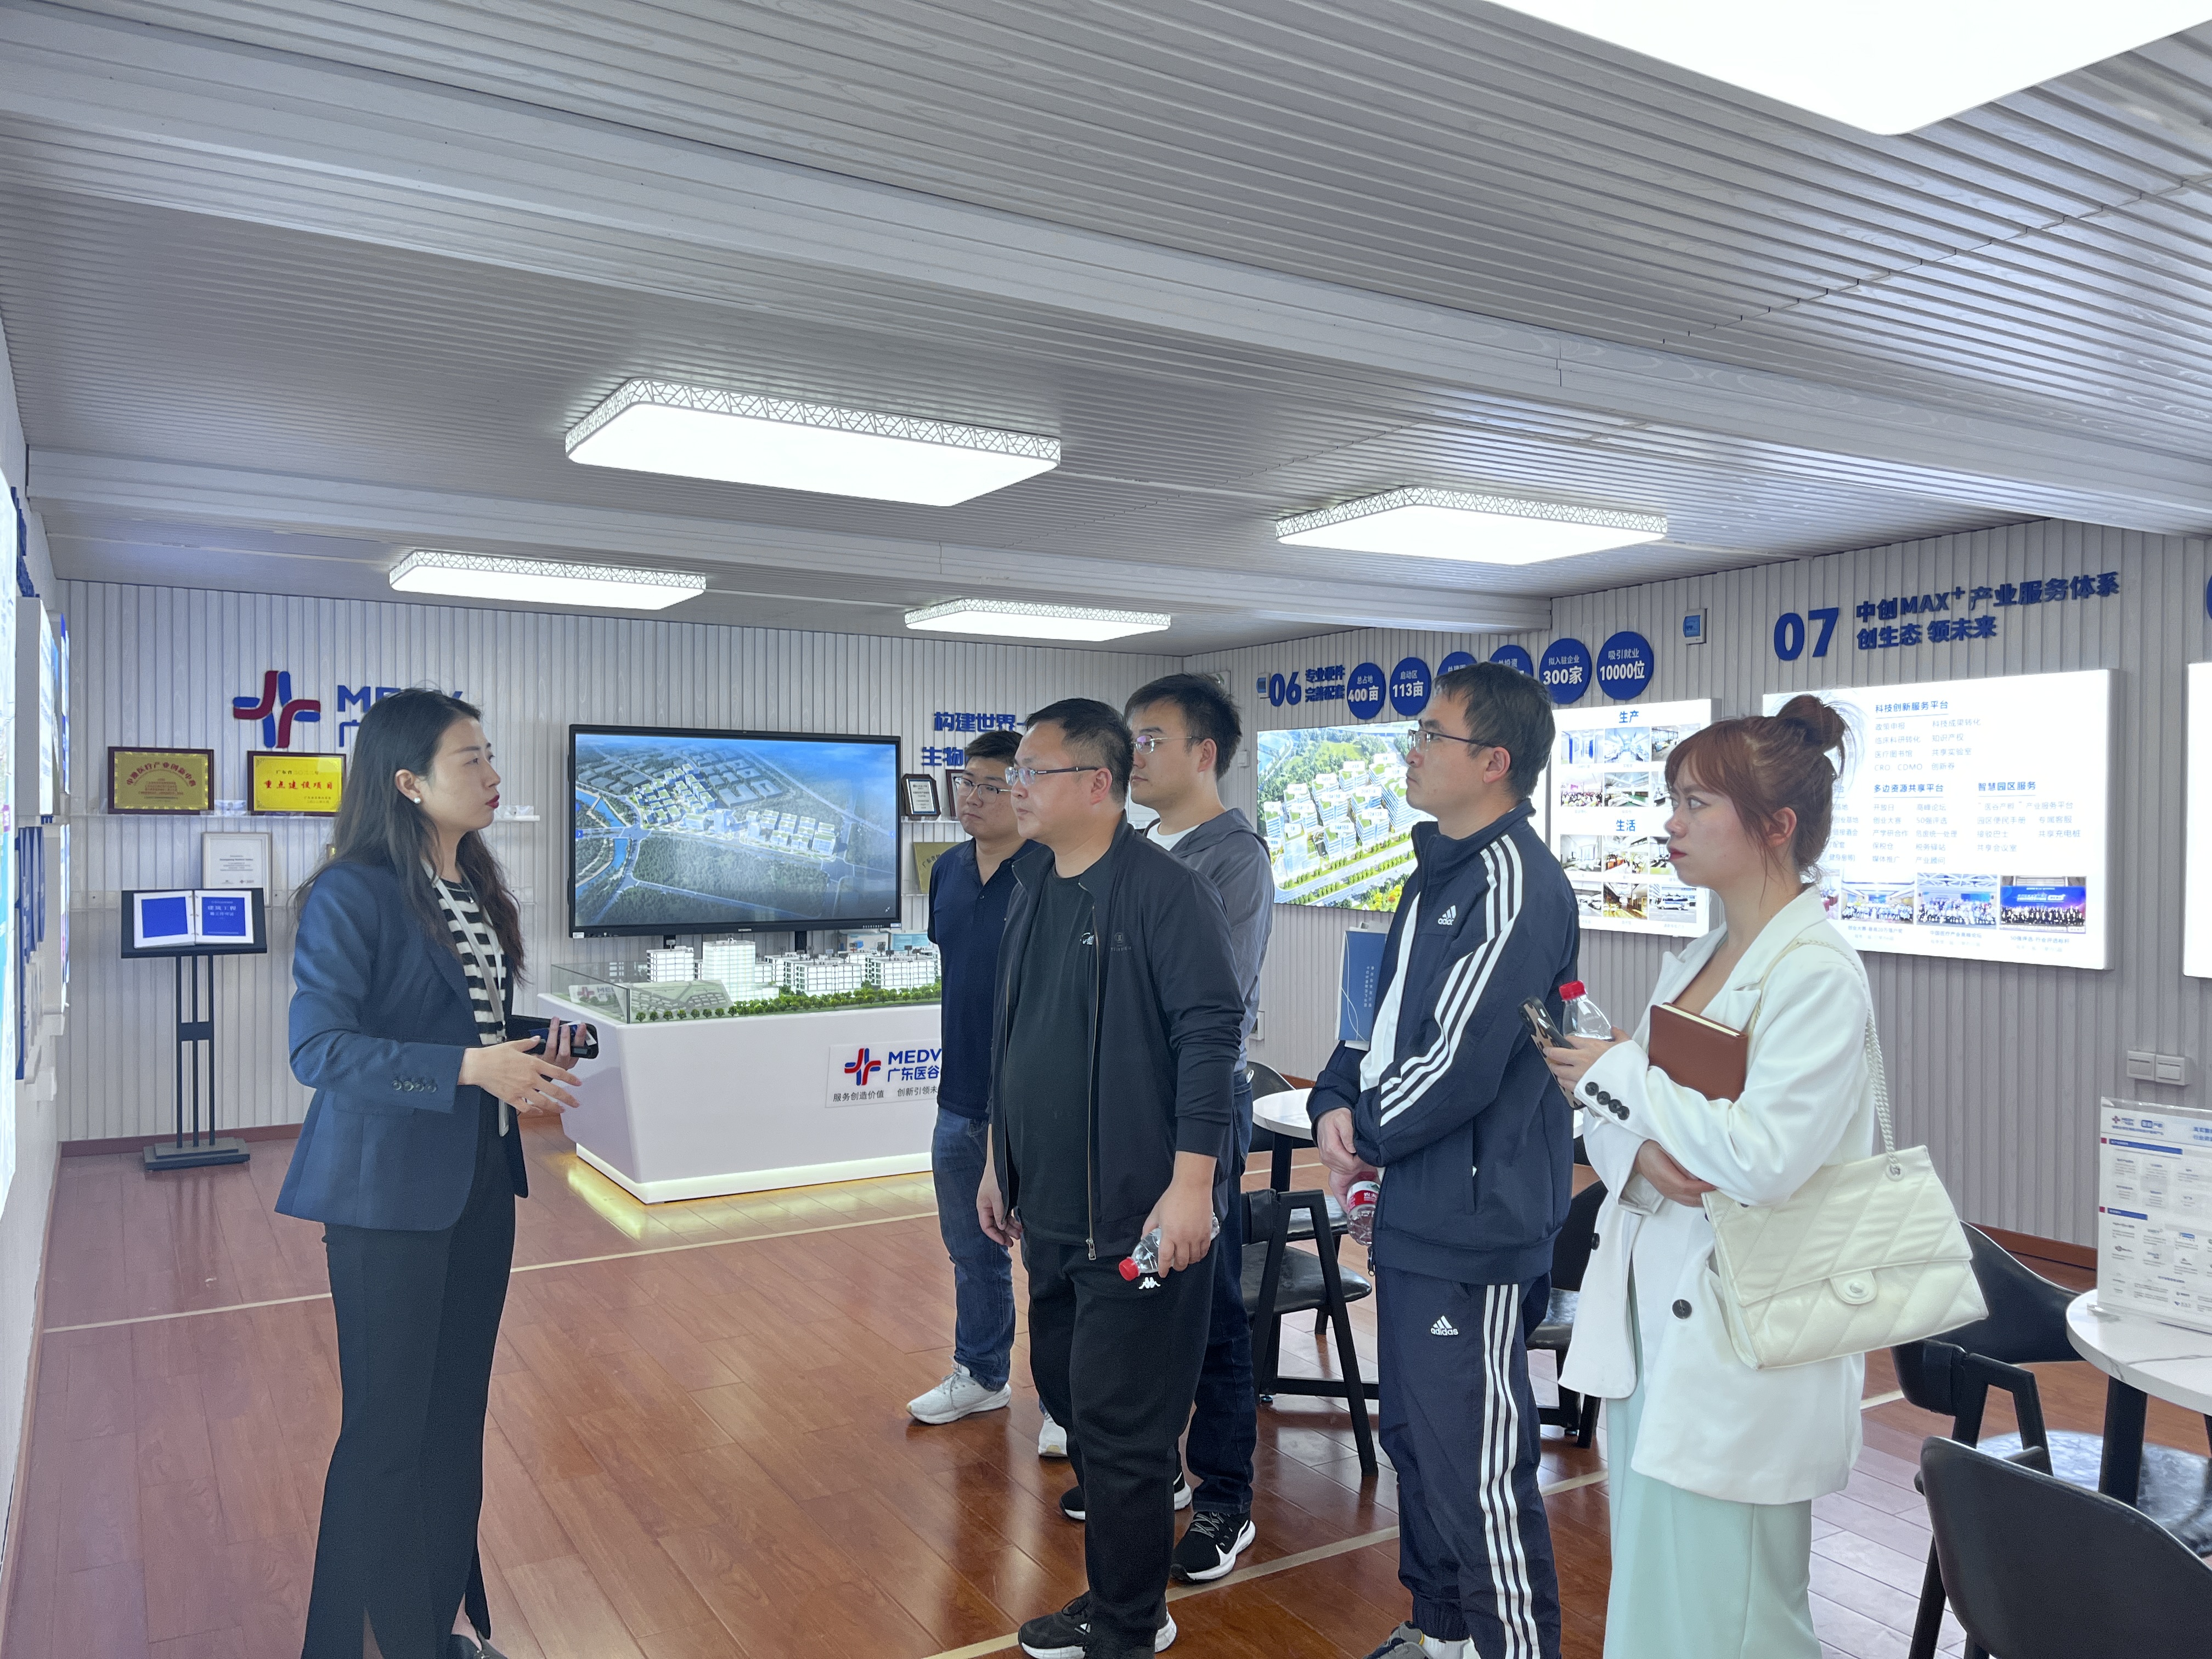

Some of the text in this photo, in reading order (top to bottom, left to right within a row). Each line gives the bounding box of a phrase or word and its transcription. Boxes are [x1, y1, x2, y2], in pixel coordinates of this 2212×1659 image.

[1774, 607, 1839, 661] 07
[1857, 616, 1997, 650] 创生态 领未来
[1548, 654, 1580, 666] 拟入驻企业
[1608, 647, 1639, 661] 吸引就业
[1305, 664, 1345, 683] 专业硬件
[1401, 670, 1418, 680] 启动区
[1543, 665, 1583, 685] 300家
[1600, 660, 1645, 681] 10000位
[1357, 675, 1373, 685] 总占地
[1269, 672, 1302, 707] 06
[1305, 684, 1345, 703] 完善配套
[1347, 685, 1379, 702] 400亩
[1392, 681, 1424, 698] 113亩
[1875, 700, 1949, 713] 科技创新服务平台
[1619, 710, 1639, 724] 生产
[1932, 718, 1981, 727] 科技成果转化
[1932, 733, 1964, 742] 知识产权
[922, 747, 968, 766] 生物
[1874, 783, 1944, 793] 多边资源共享平台
[1978, 781, 2036, 792] 智慧园区服务
[1916, 803, 1946, 811] 高峰论坛
[1616, 819, 1637, 832] 生活
[1977, 816, 2073, 825] 园区便民手册 专属客服
[1872, 829, 1909, 837] 产学研合作
[2038, 829, 2081, 838] 共享充电桩
[1977, 844, 2018, 852] 共享会议室
[1915, 856, 1946, 865] 产业顾问
[888, 1048, 942, 1065] MEDV
[888, 1065, 940, 1082] 广东医谷
[833, 1090, 884, 1102] 服务创造价值
[1430, 1328, 1459, 1336] adidas
